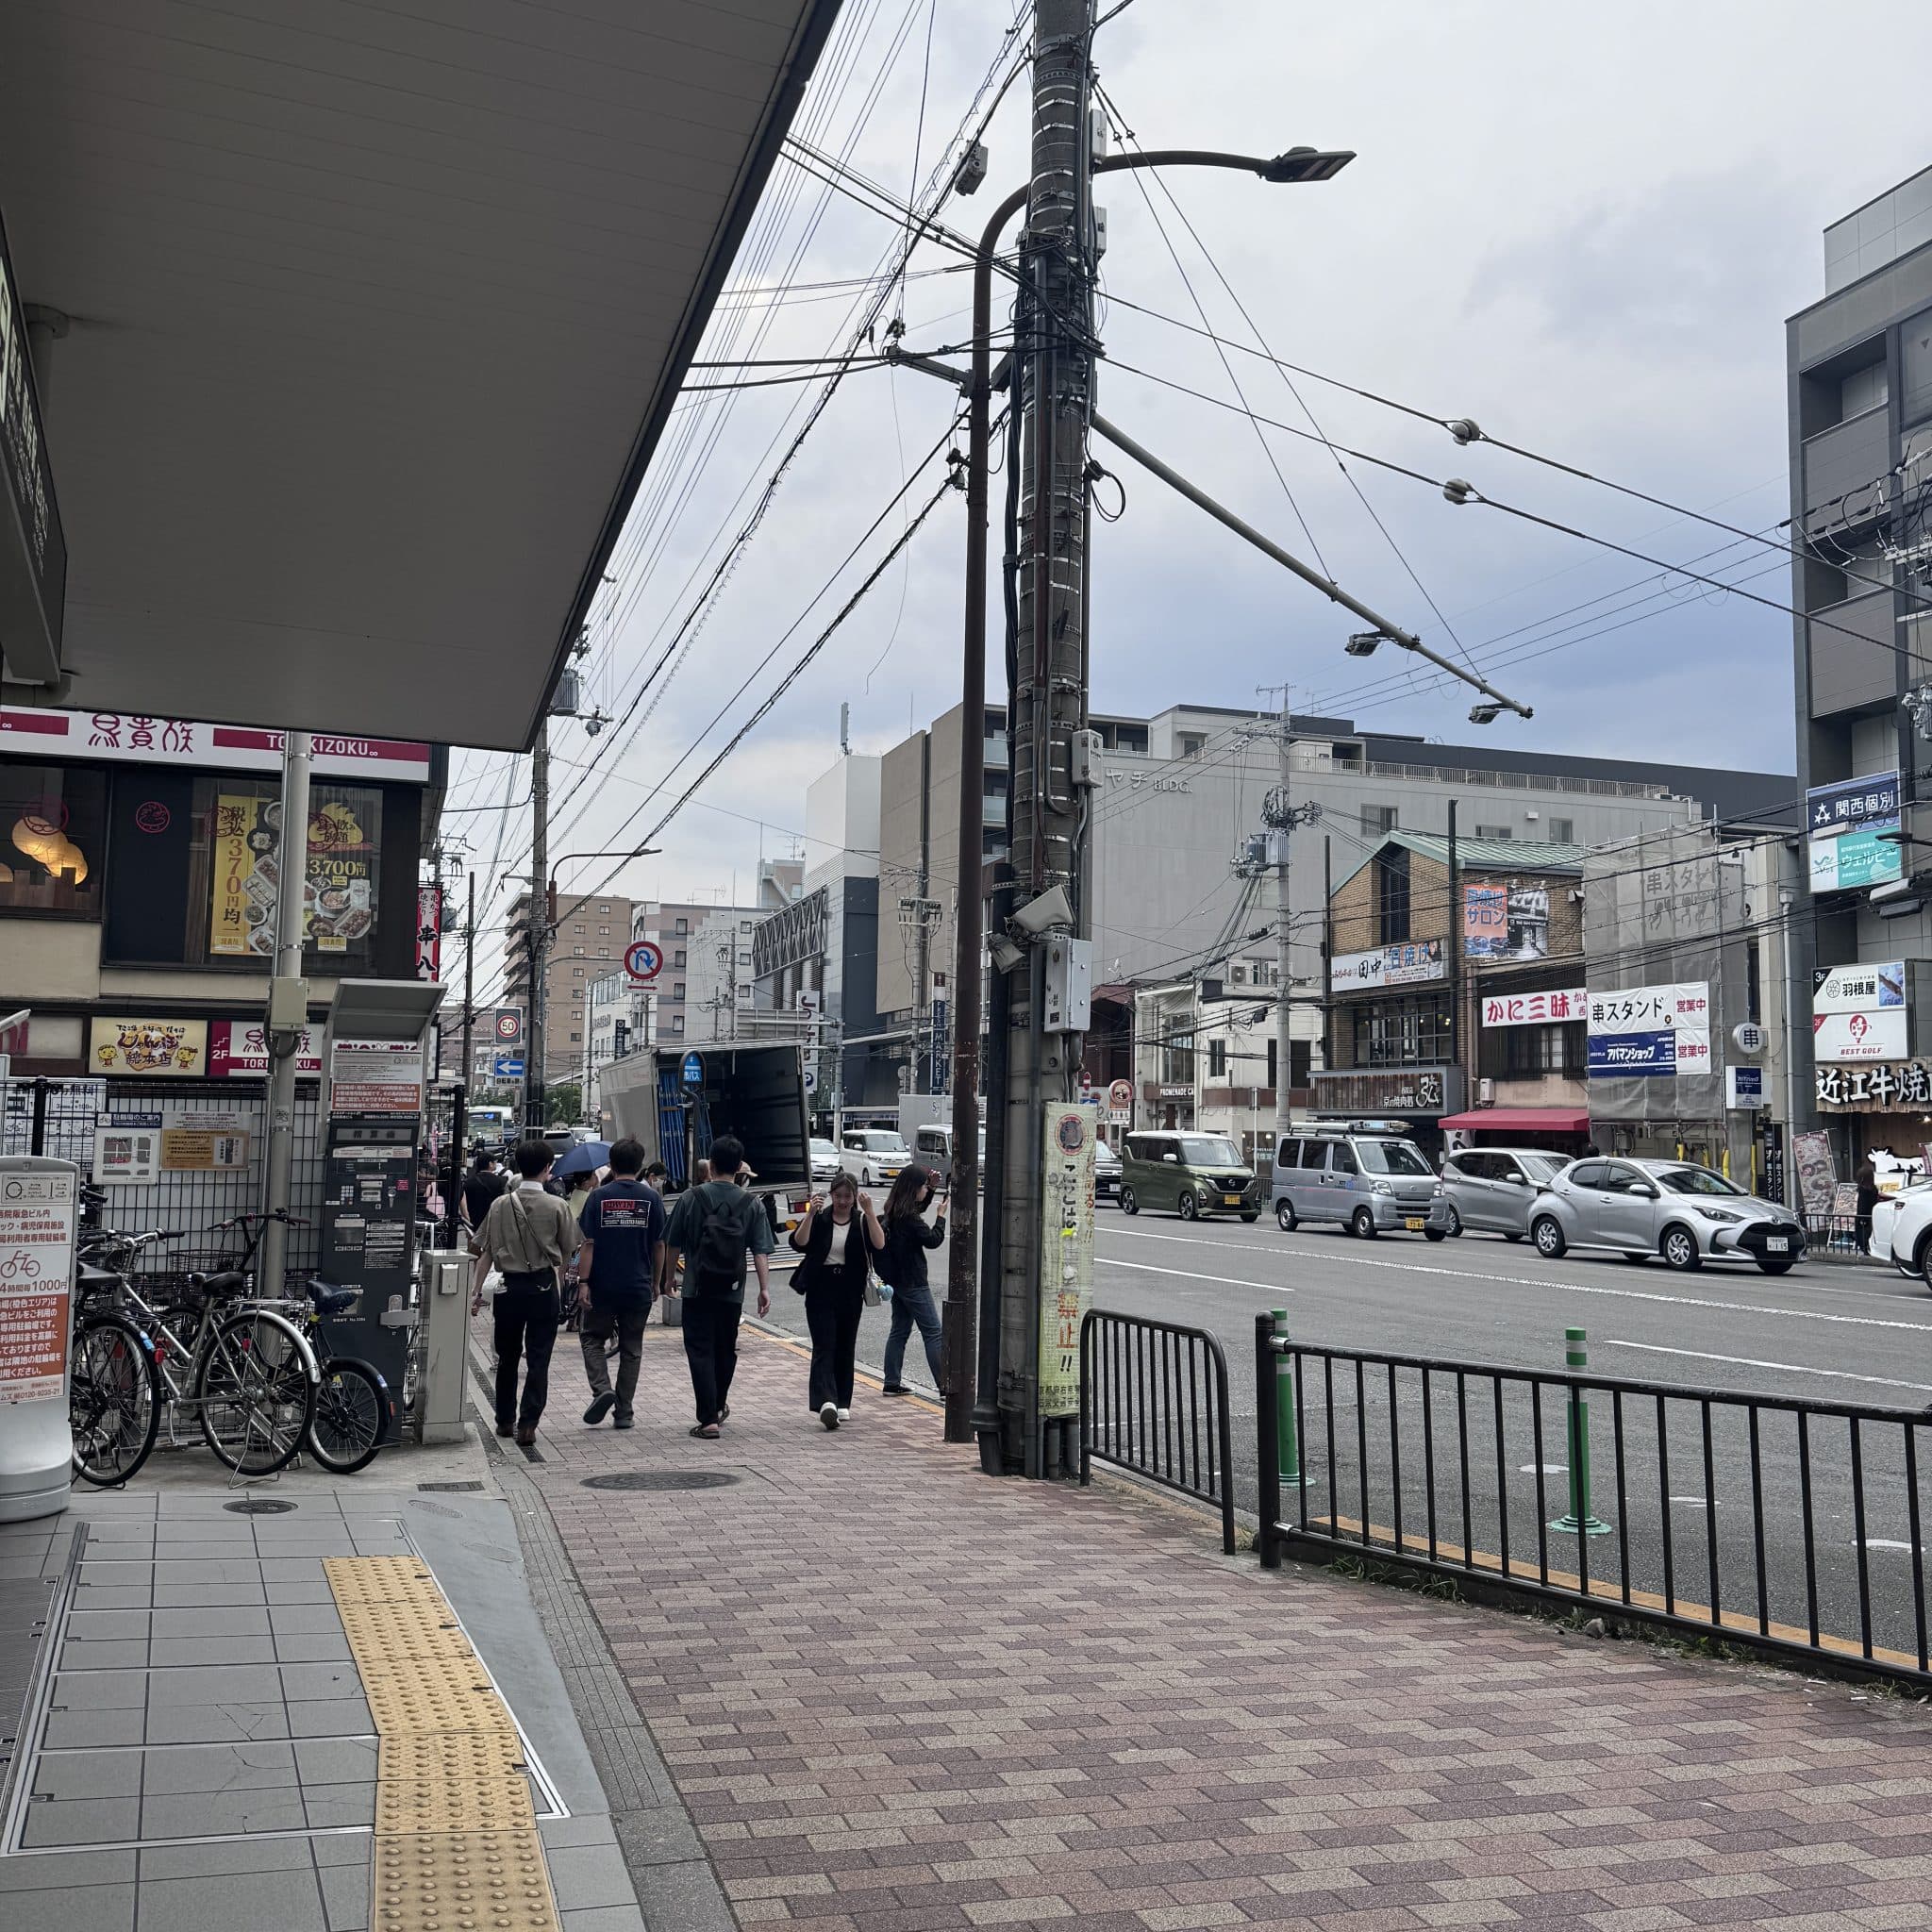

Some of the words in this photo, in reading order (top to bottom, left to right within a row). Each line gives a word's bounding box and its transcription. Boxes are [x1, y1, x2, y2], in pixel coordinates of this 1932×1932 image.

[267, 734, 368, 756] TOKIZOKU
[1835, 791, 1894, 818] 関西個別
[1467, 908, 1505, 925] サロン
[1815, 972, 1826, 983] 3F
[1841, 981, 1876, 997] 羽根屋
[1592, 996, 1664, 1024] 串スタンド
[1676, 997, 1707, 1013] 営業中
[502, 1022, 514, 1031] 50
[1743, 1028, 1758, 1047] 串
[212, 1050, 228, 1059] 2F
[934, 1032, 943, 1085] MARKET
[1607, 1044, 1655, 1061] アパマンショップ
[1677, 1042, 1708, 1058] 営業中
[243, 1058, 310, 1069] TORIKU
[1815, 1063, 1932, 1106] 近江牛焼
